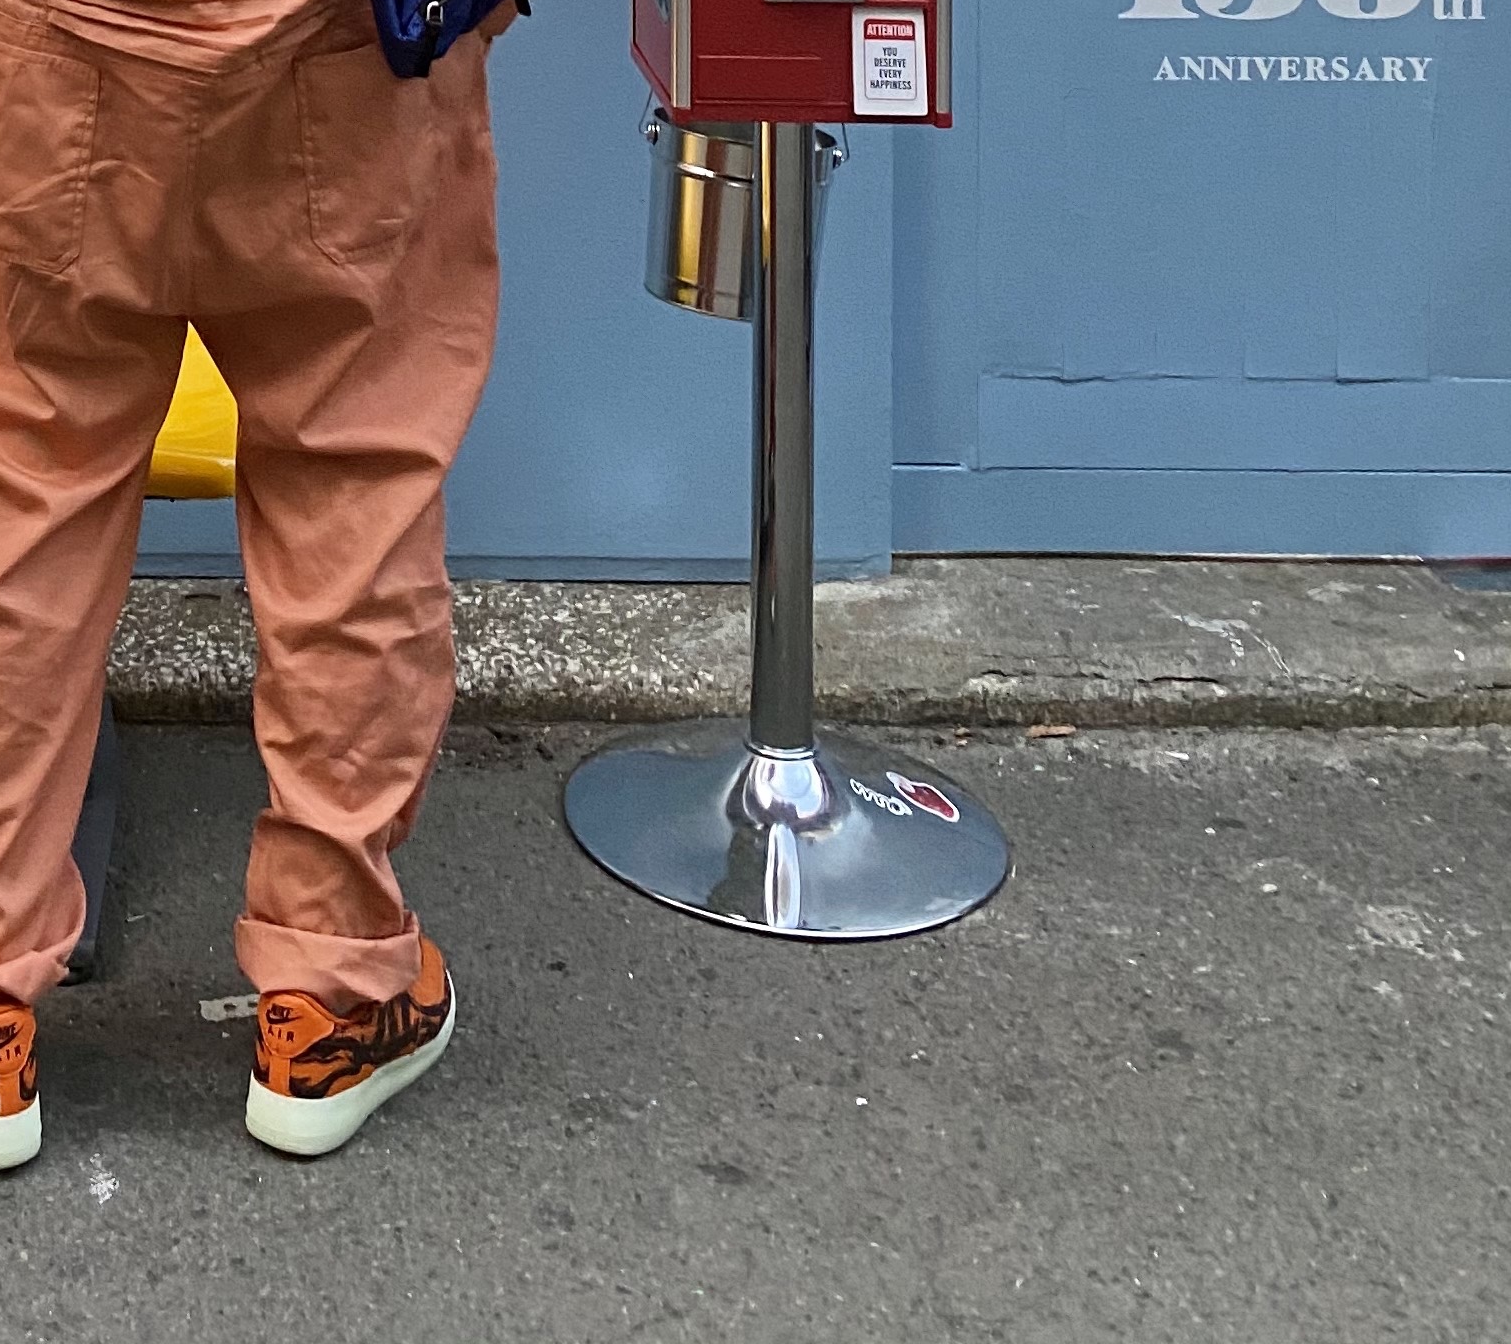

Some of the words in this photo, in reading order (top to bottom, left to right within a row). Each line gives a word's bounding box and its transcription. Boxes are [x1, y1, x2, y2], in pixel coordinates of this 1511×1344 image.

[866, 23, 914, 37] ATTENTION
[882, 47, 898, 57] YOU
[874, 57, 907, 68] DESERVE
[879, 69, 902, 79] EVERY
[1153, 56, 1433, 83] ANNIVERSARY
[870, 80, 912, 90] HAPPINESS
[267, 1024, 295, 1042] AIR
